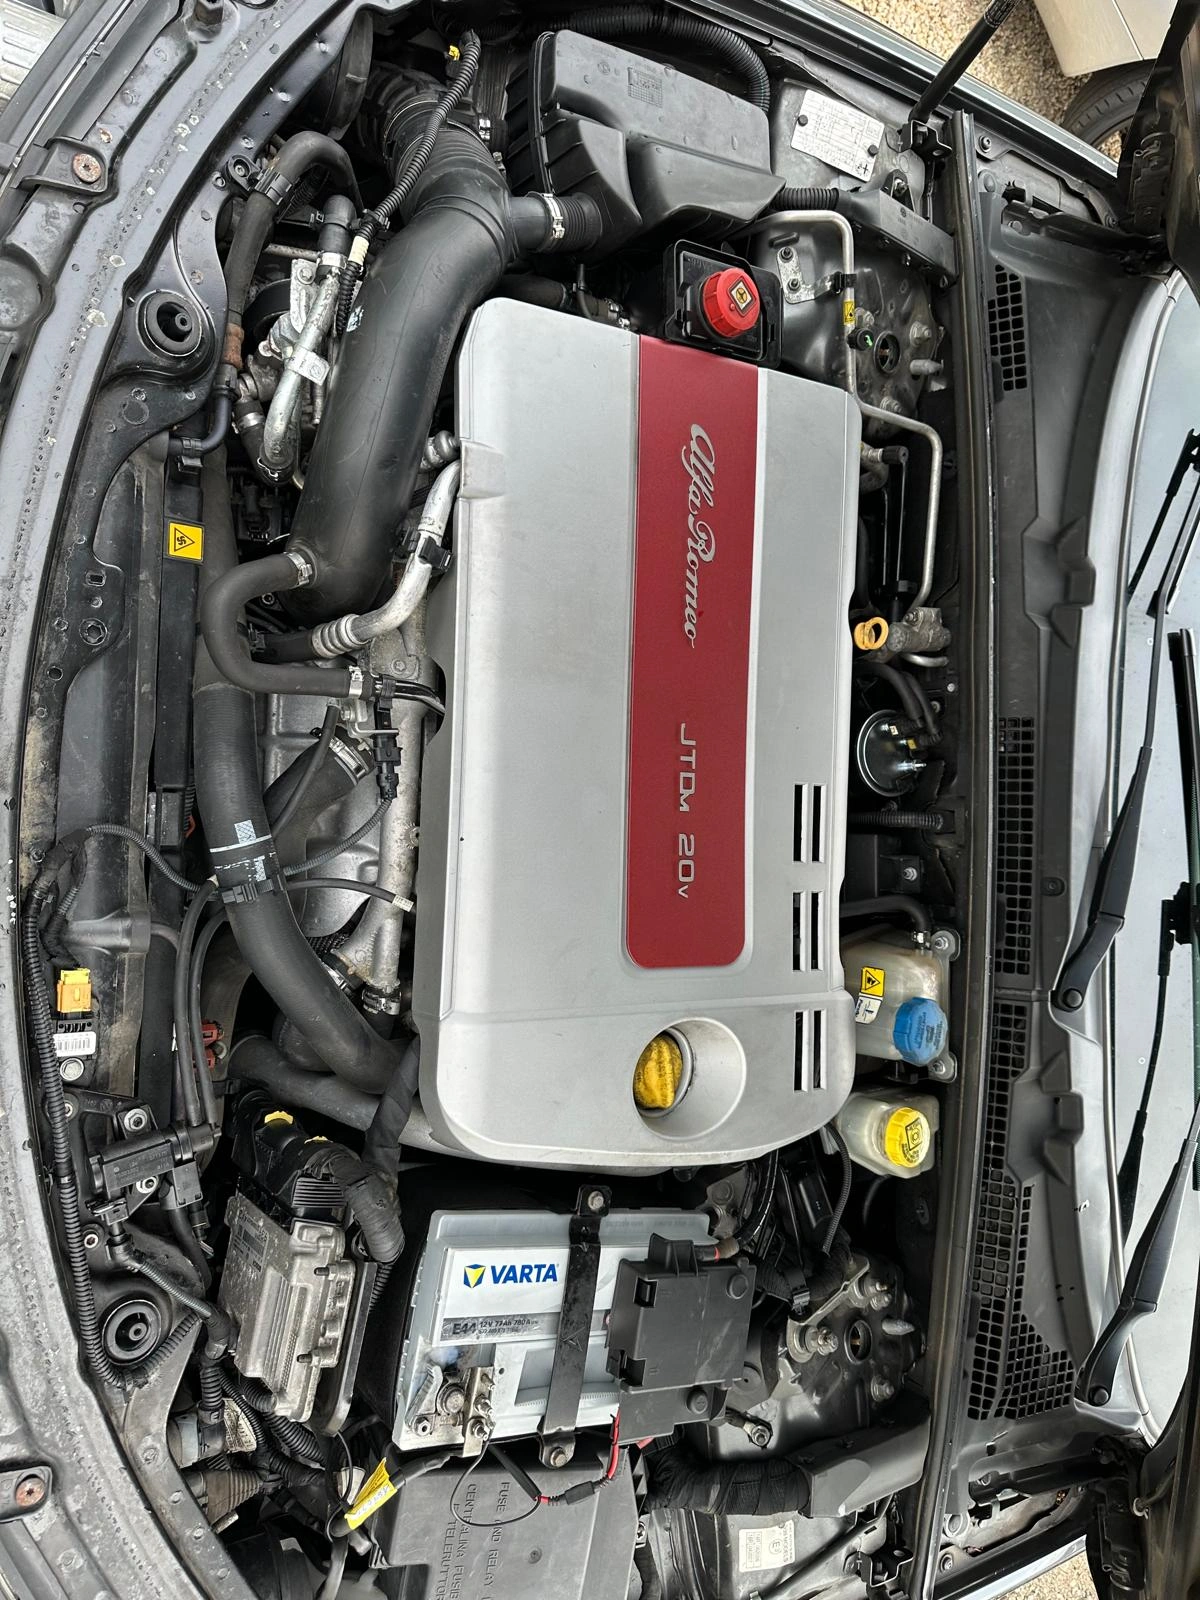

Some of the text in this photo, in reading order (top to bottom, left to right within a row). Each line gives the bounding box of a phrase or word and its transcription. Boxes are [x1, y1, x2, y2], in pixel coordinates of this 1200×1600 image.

[681, 423, 715, 649] Alfa Romeo
[490, 1264, 558, 1284] VARTA
[452, 1322, 476, 1335] E44
[496, 1482, 510, 1512] FUSE
[484, 1548, 499, 1587] RELAY
